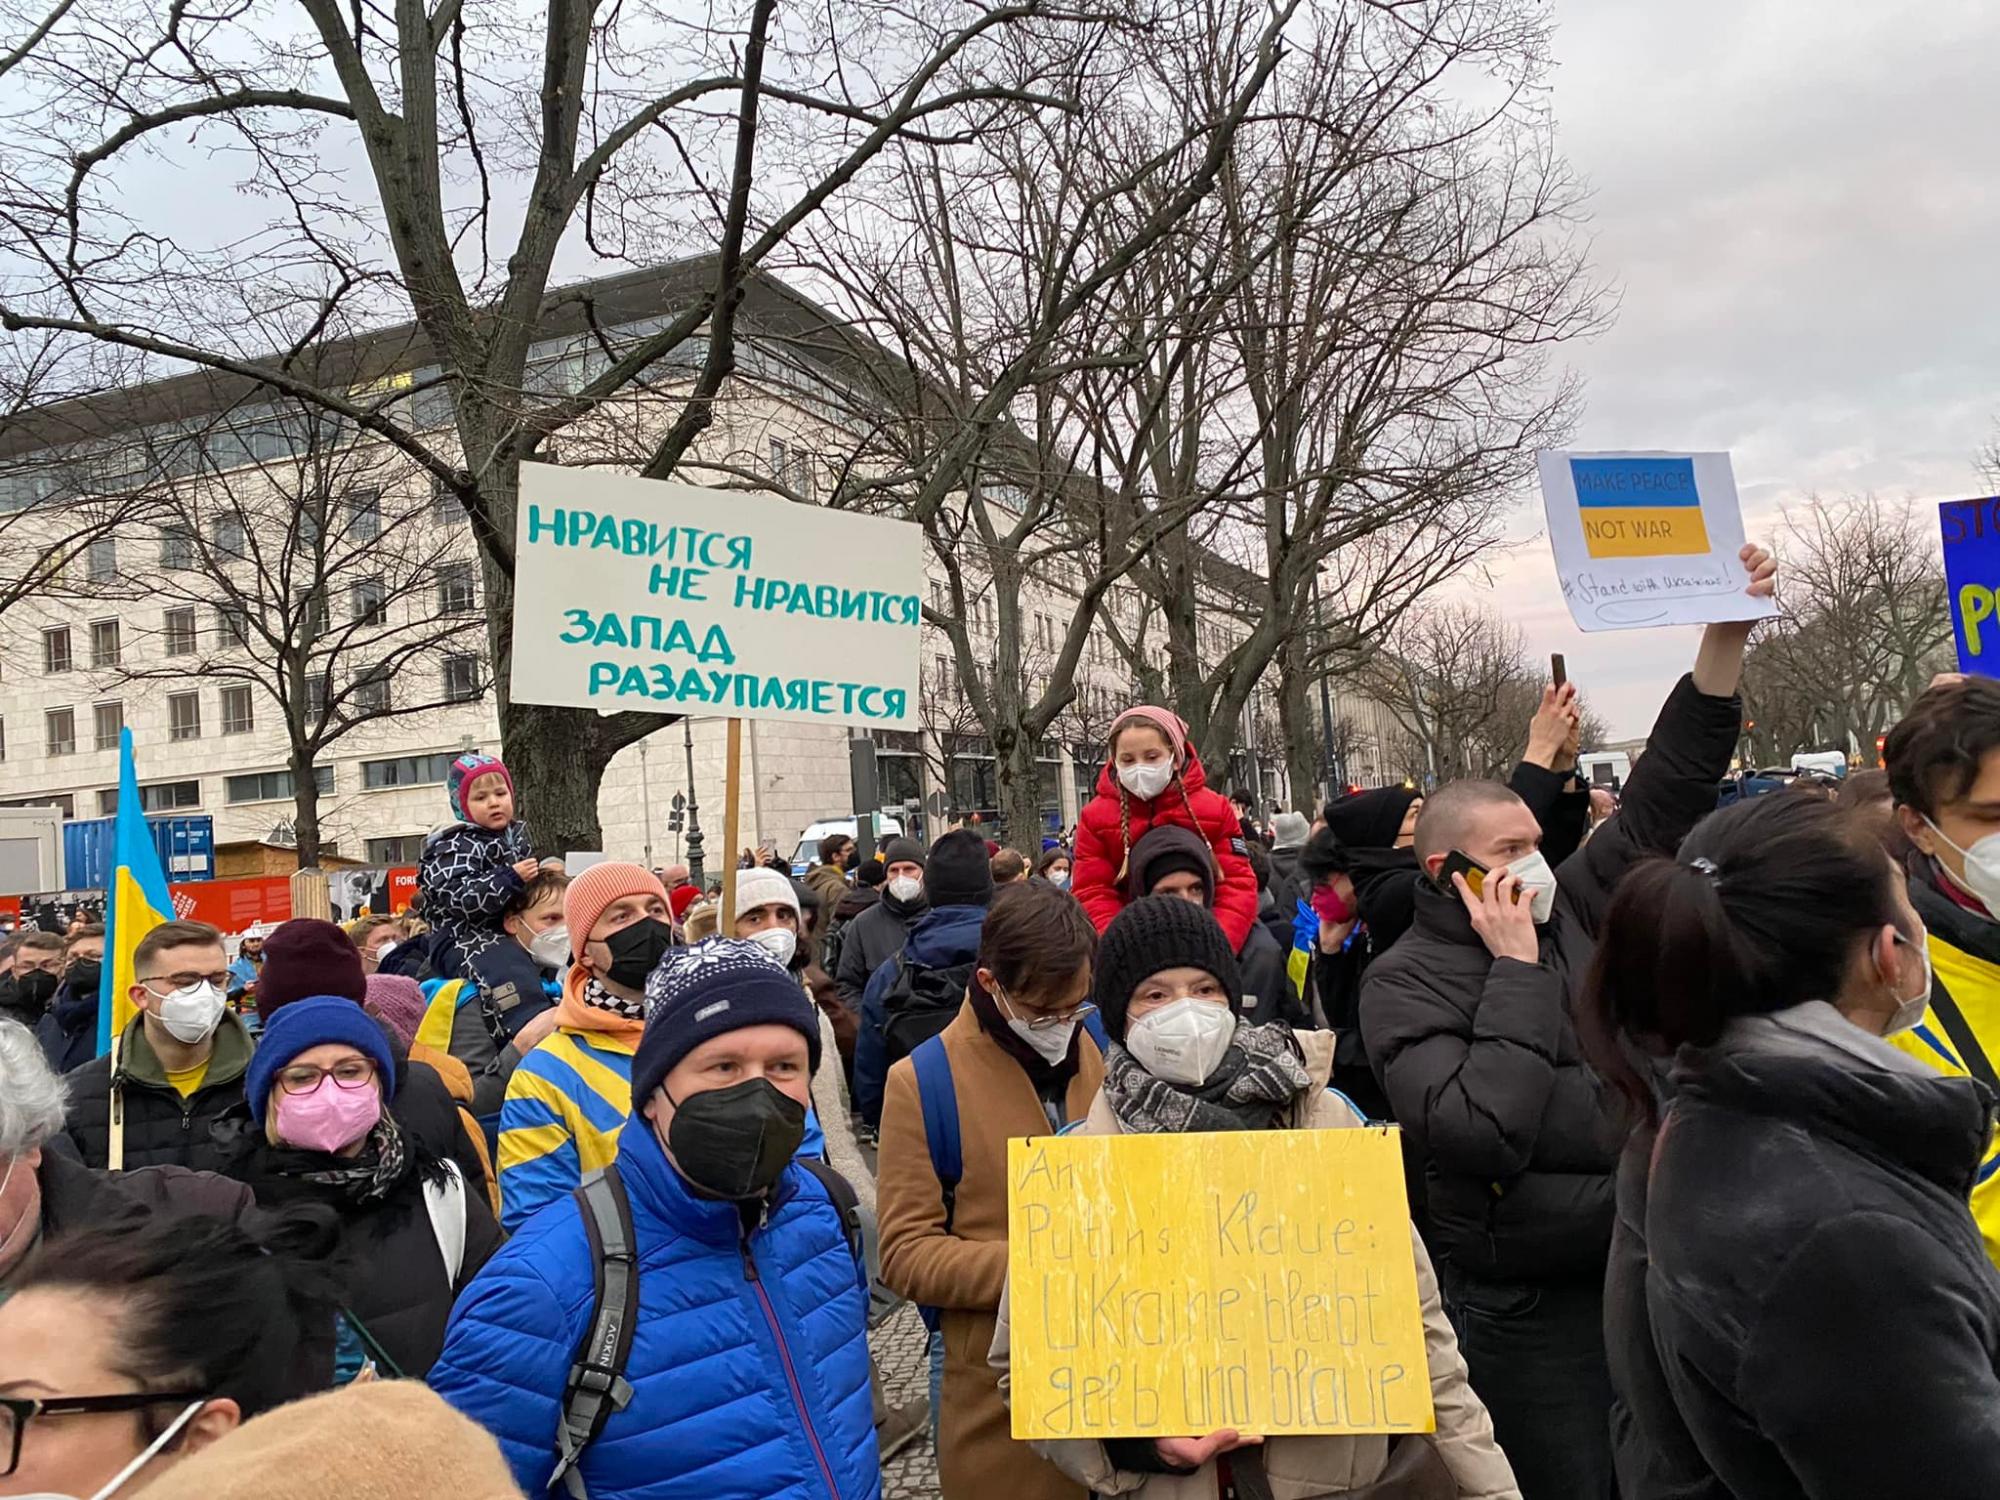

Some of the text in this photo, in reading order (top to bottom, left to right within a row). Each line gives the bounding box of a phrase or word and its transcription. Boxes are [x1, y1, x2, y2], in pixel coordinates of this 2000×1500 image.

[1577, 471, 1689, 491] MAKE PEACE
[529, 504, 752, 570] НРАВИТСЯ
[1585, 520, 1673, 539] NOT WAR
[648, 563, 920, 626] НЕ НРАВИТСЯ
[1959, 583, 2000, 656] P
[559, 608, 736, 665] ЗАПАД
[588, 661, 907, 719] РАЗДУПЛЯЕТСЯ
[1019, 1147, 1073, 1192] An
[1216, 1190, 1376, 1257] Klaue:
[1263, 1268, 1388, 1346] bleibt
[1042, 1364, 1159, 1434] gelb
[1269, 1347, 1412, 1428] blaue
